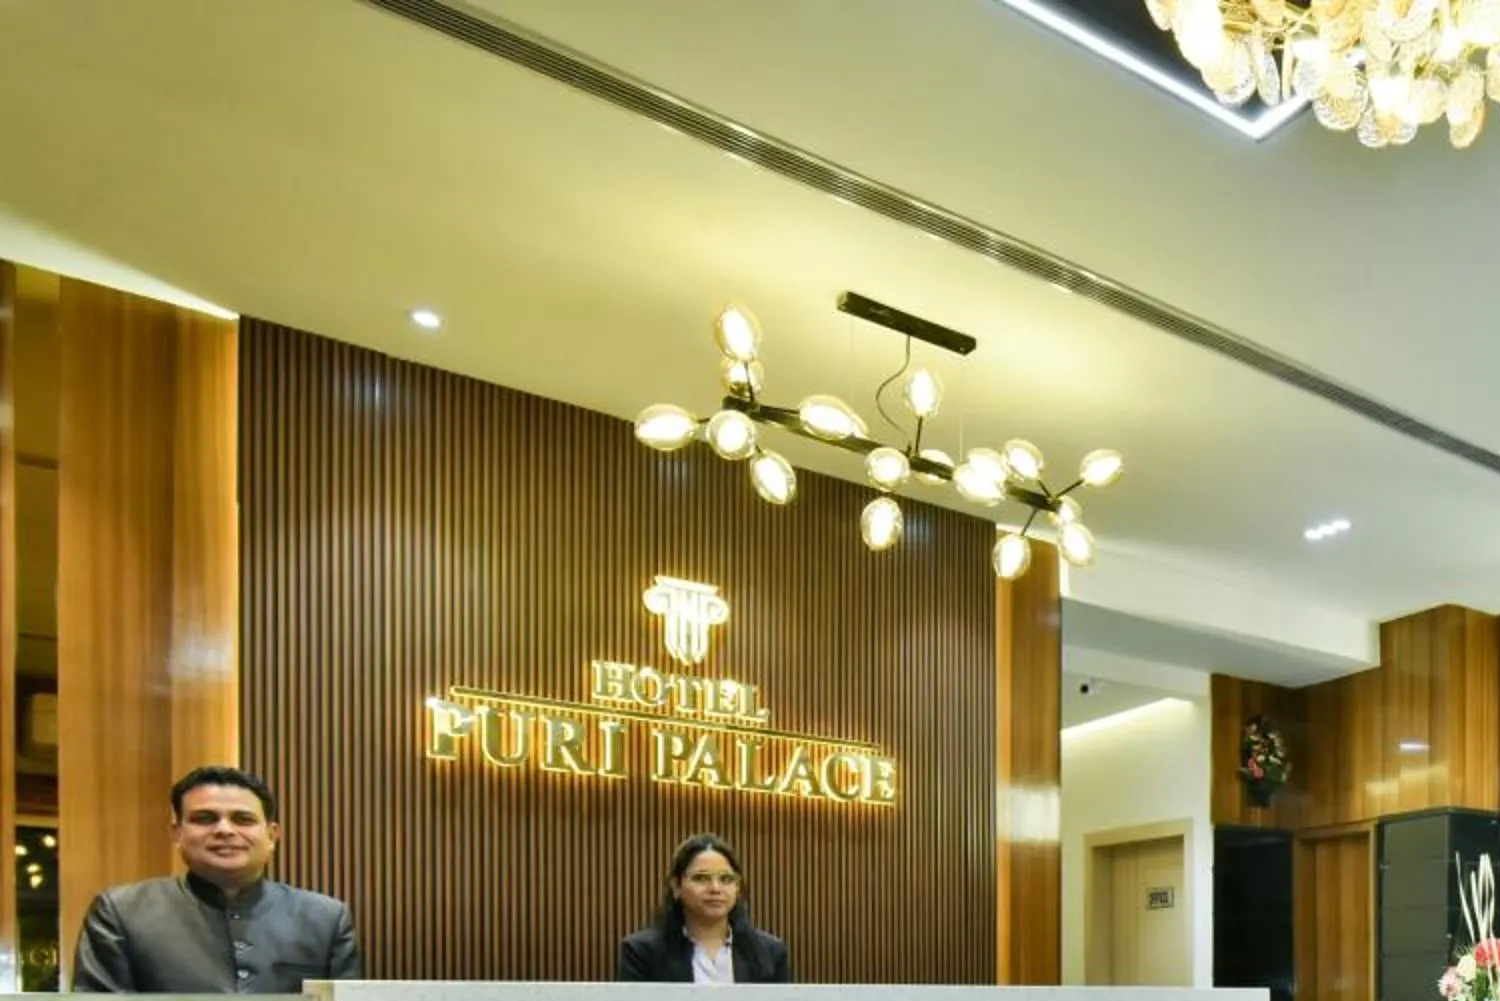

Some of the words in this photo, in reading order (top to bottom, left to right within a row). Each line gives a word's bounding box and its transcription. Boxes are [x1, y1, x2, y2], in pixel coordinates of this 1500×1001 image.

[592, 659, 769, 721] HOTEL
[426, 698, 626, 778] PURI
[651, 727, 897, 805] PALACE
